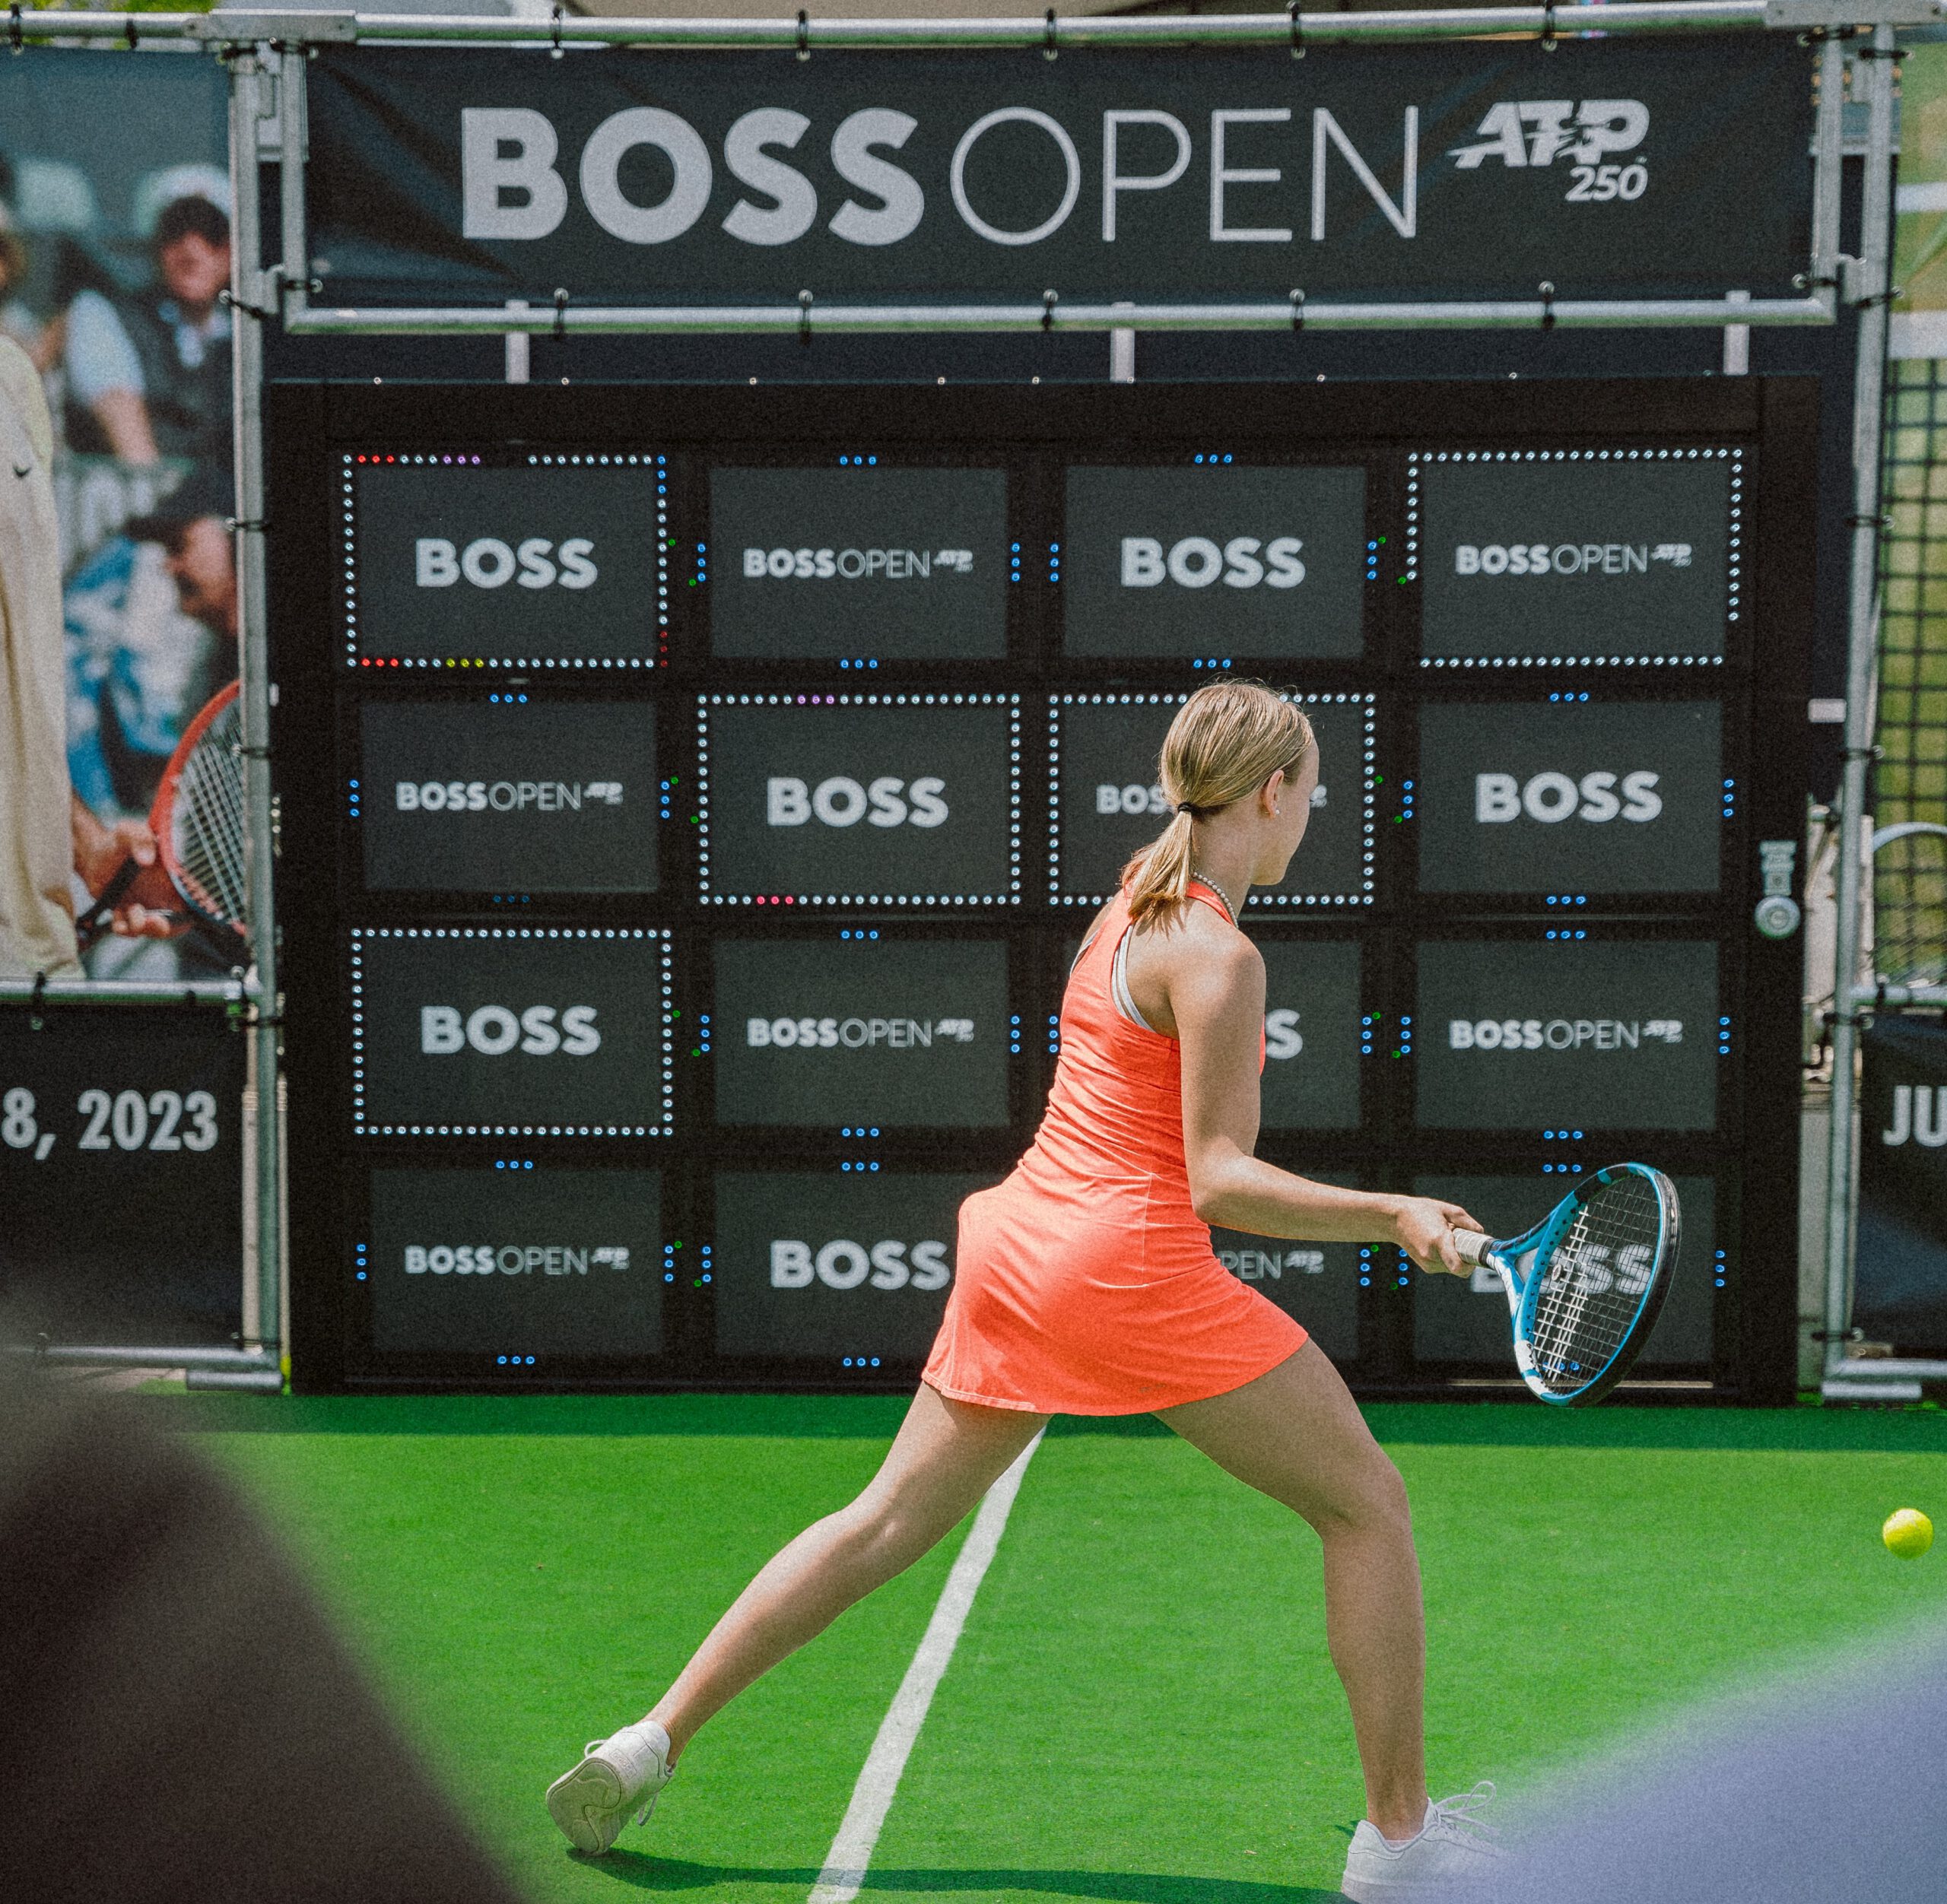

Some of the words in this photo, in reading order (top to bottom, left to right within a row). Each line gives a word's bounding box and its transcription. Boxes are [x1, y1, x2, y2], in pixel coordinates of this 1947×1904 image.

[461, 107, 925, 246] BOSS
[950, 106, 1419, 243] OPEN
[1447, 100, 1650, 169] ATP
[1564, 164, 1649, 202] 250
[415, 537, 599, 589] BOSS
[1121, 537, 1307, 589] BOSS
[767, 776, 949, 828] BOSS
[1096, 784, 1164, 814] BOS
[1475, 770, 1663, 823] BOSS
[421, 1005, 602, 1055] BOSS
[78, 1089, 219, 1151] 2023
[770, 1239, 951, 1290] BOSS
[1219, 1250, 1282, 1280] PEN
